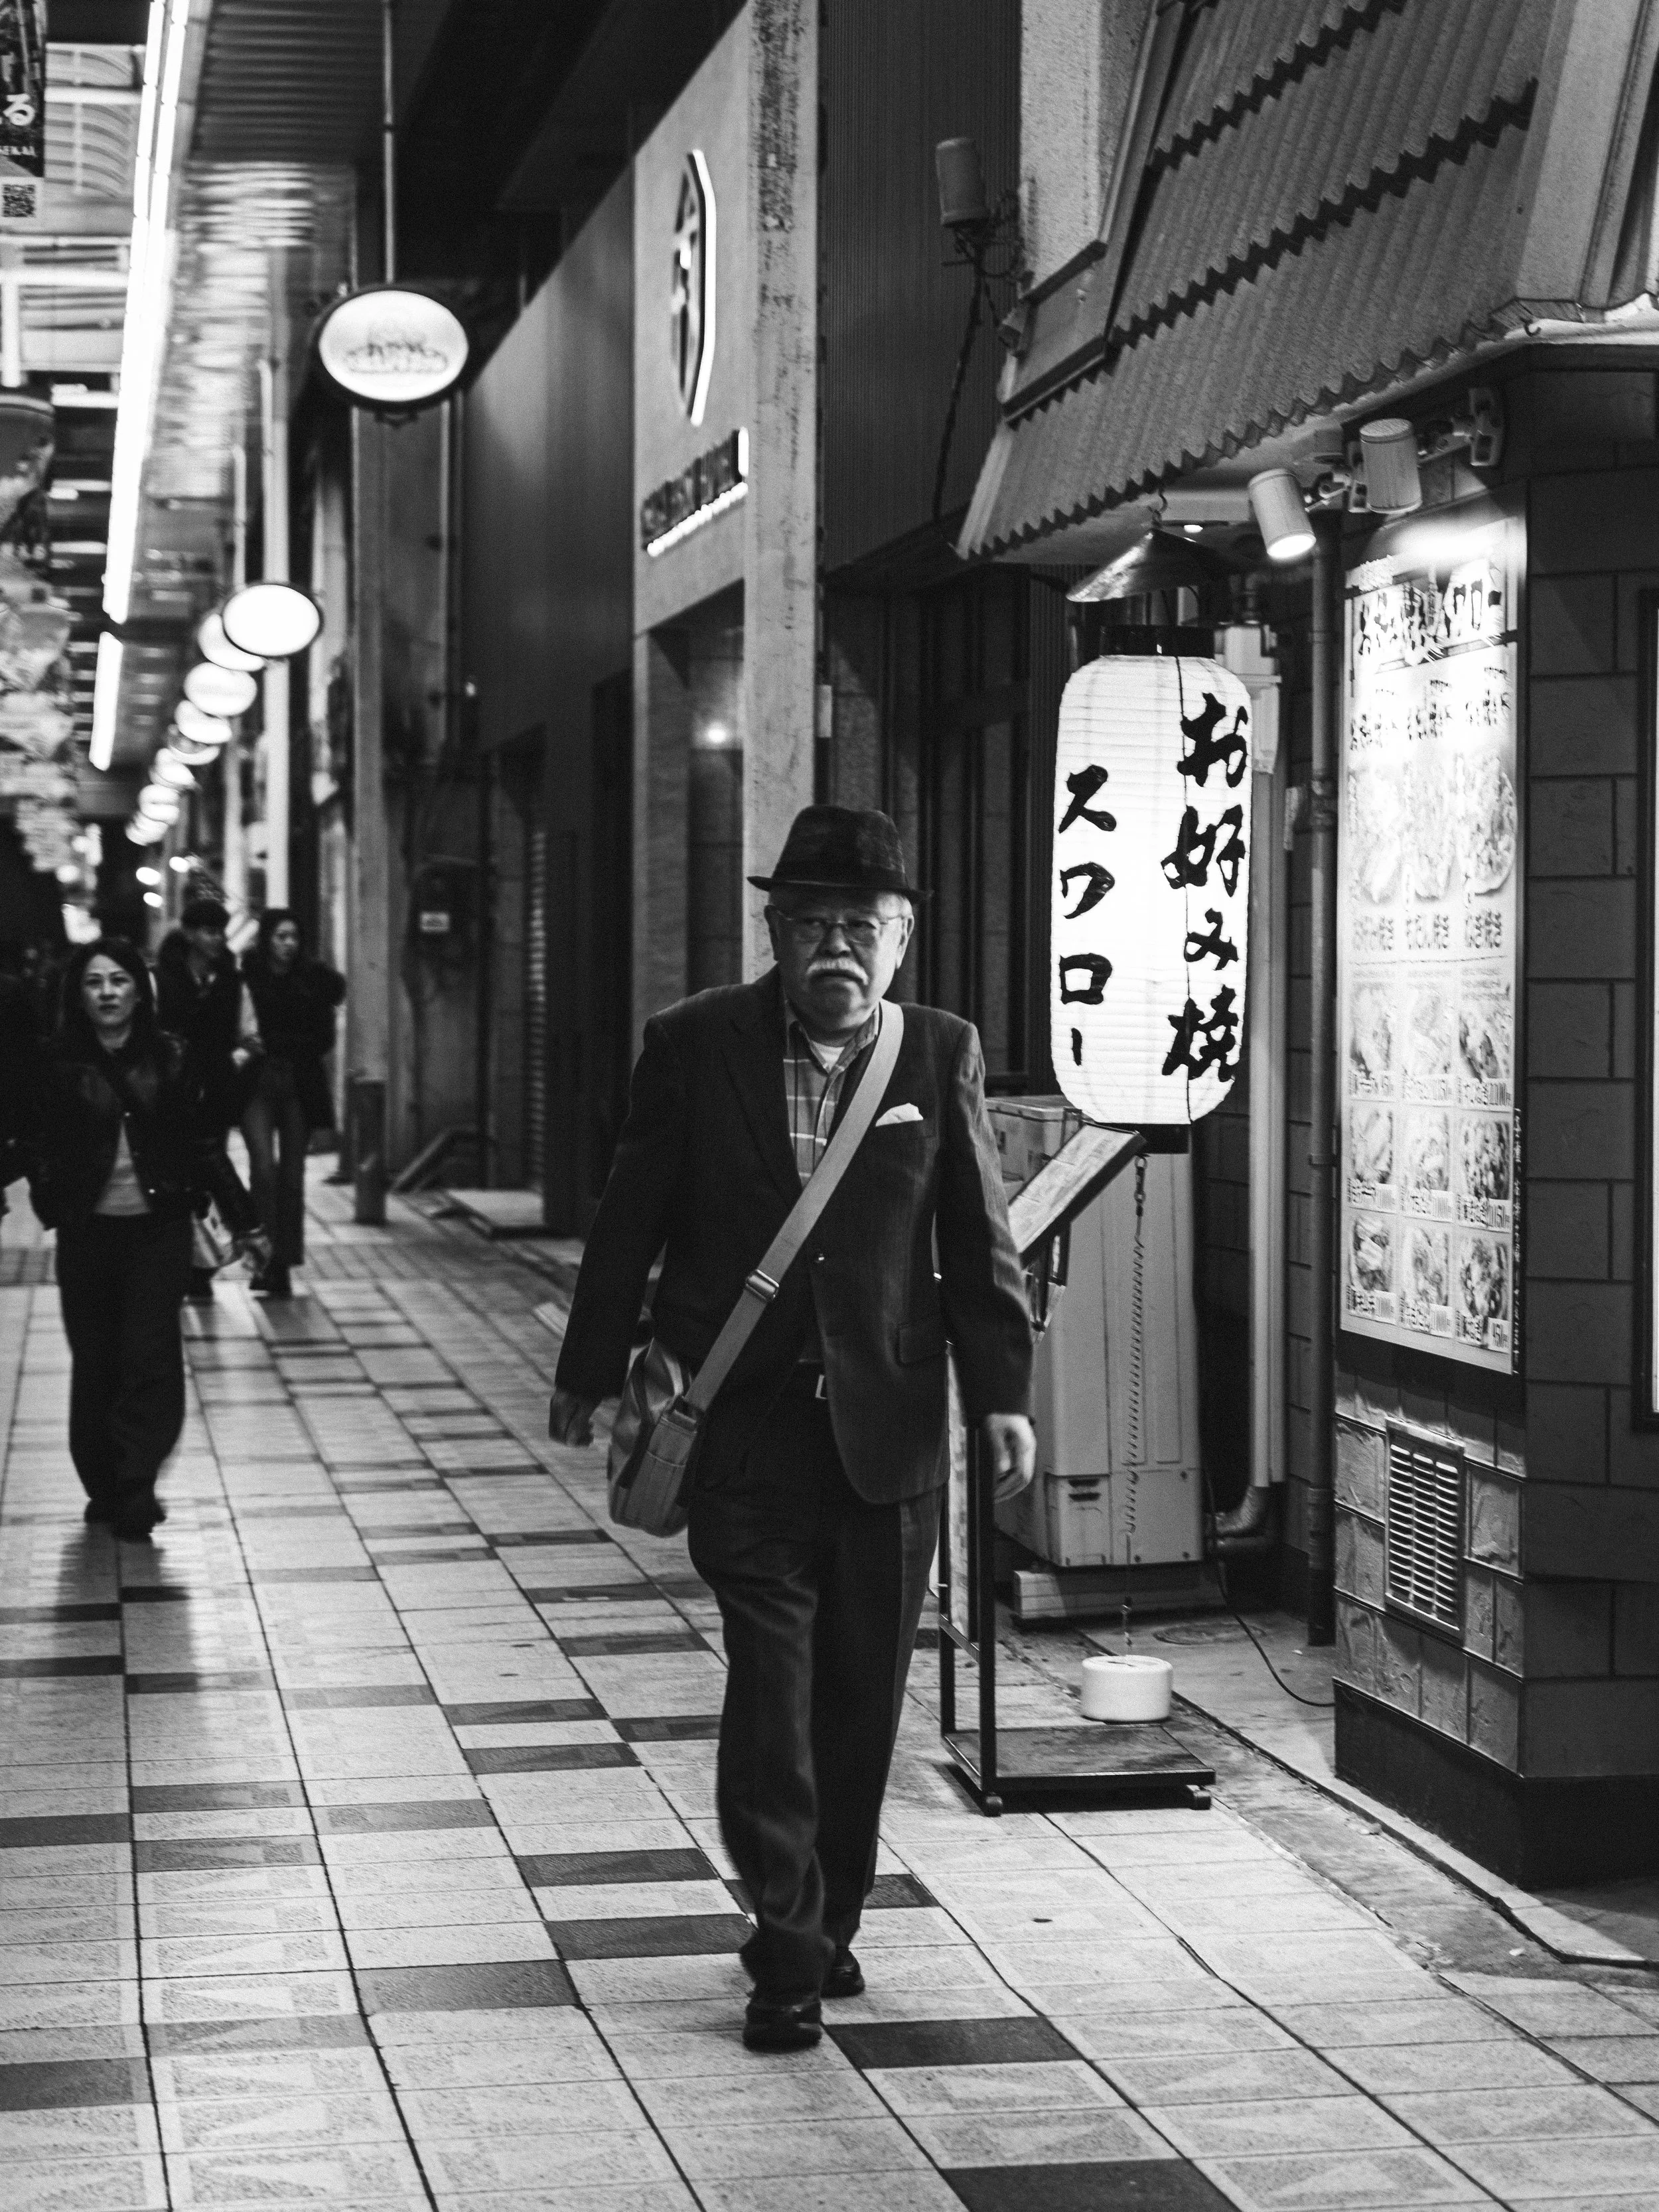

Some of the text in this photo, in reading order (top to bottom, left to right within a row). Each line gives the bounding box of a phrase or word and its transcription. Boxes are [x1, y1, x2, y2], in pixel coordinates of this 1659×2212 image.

[1059, 764, 1117, 1066] スワロー
[1161, 693, 1248, 1083] お好み焼
